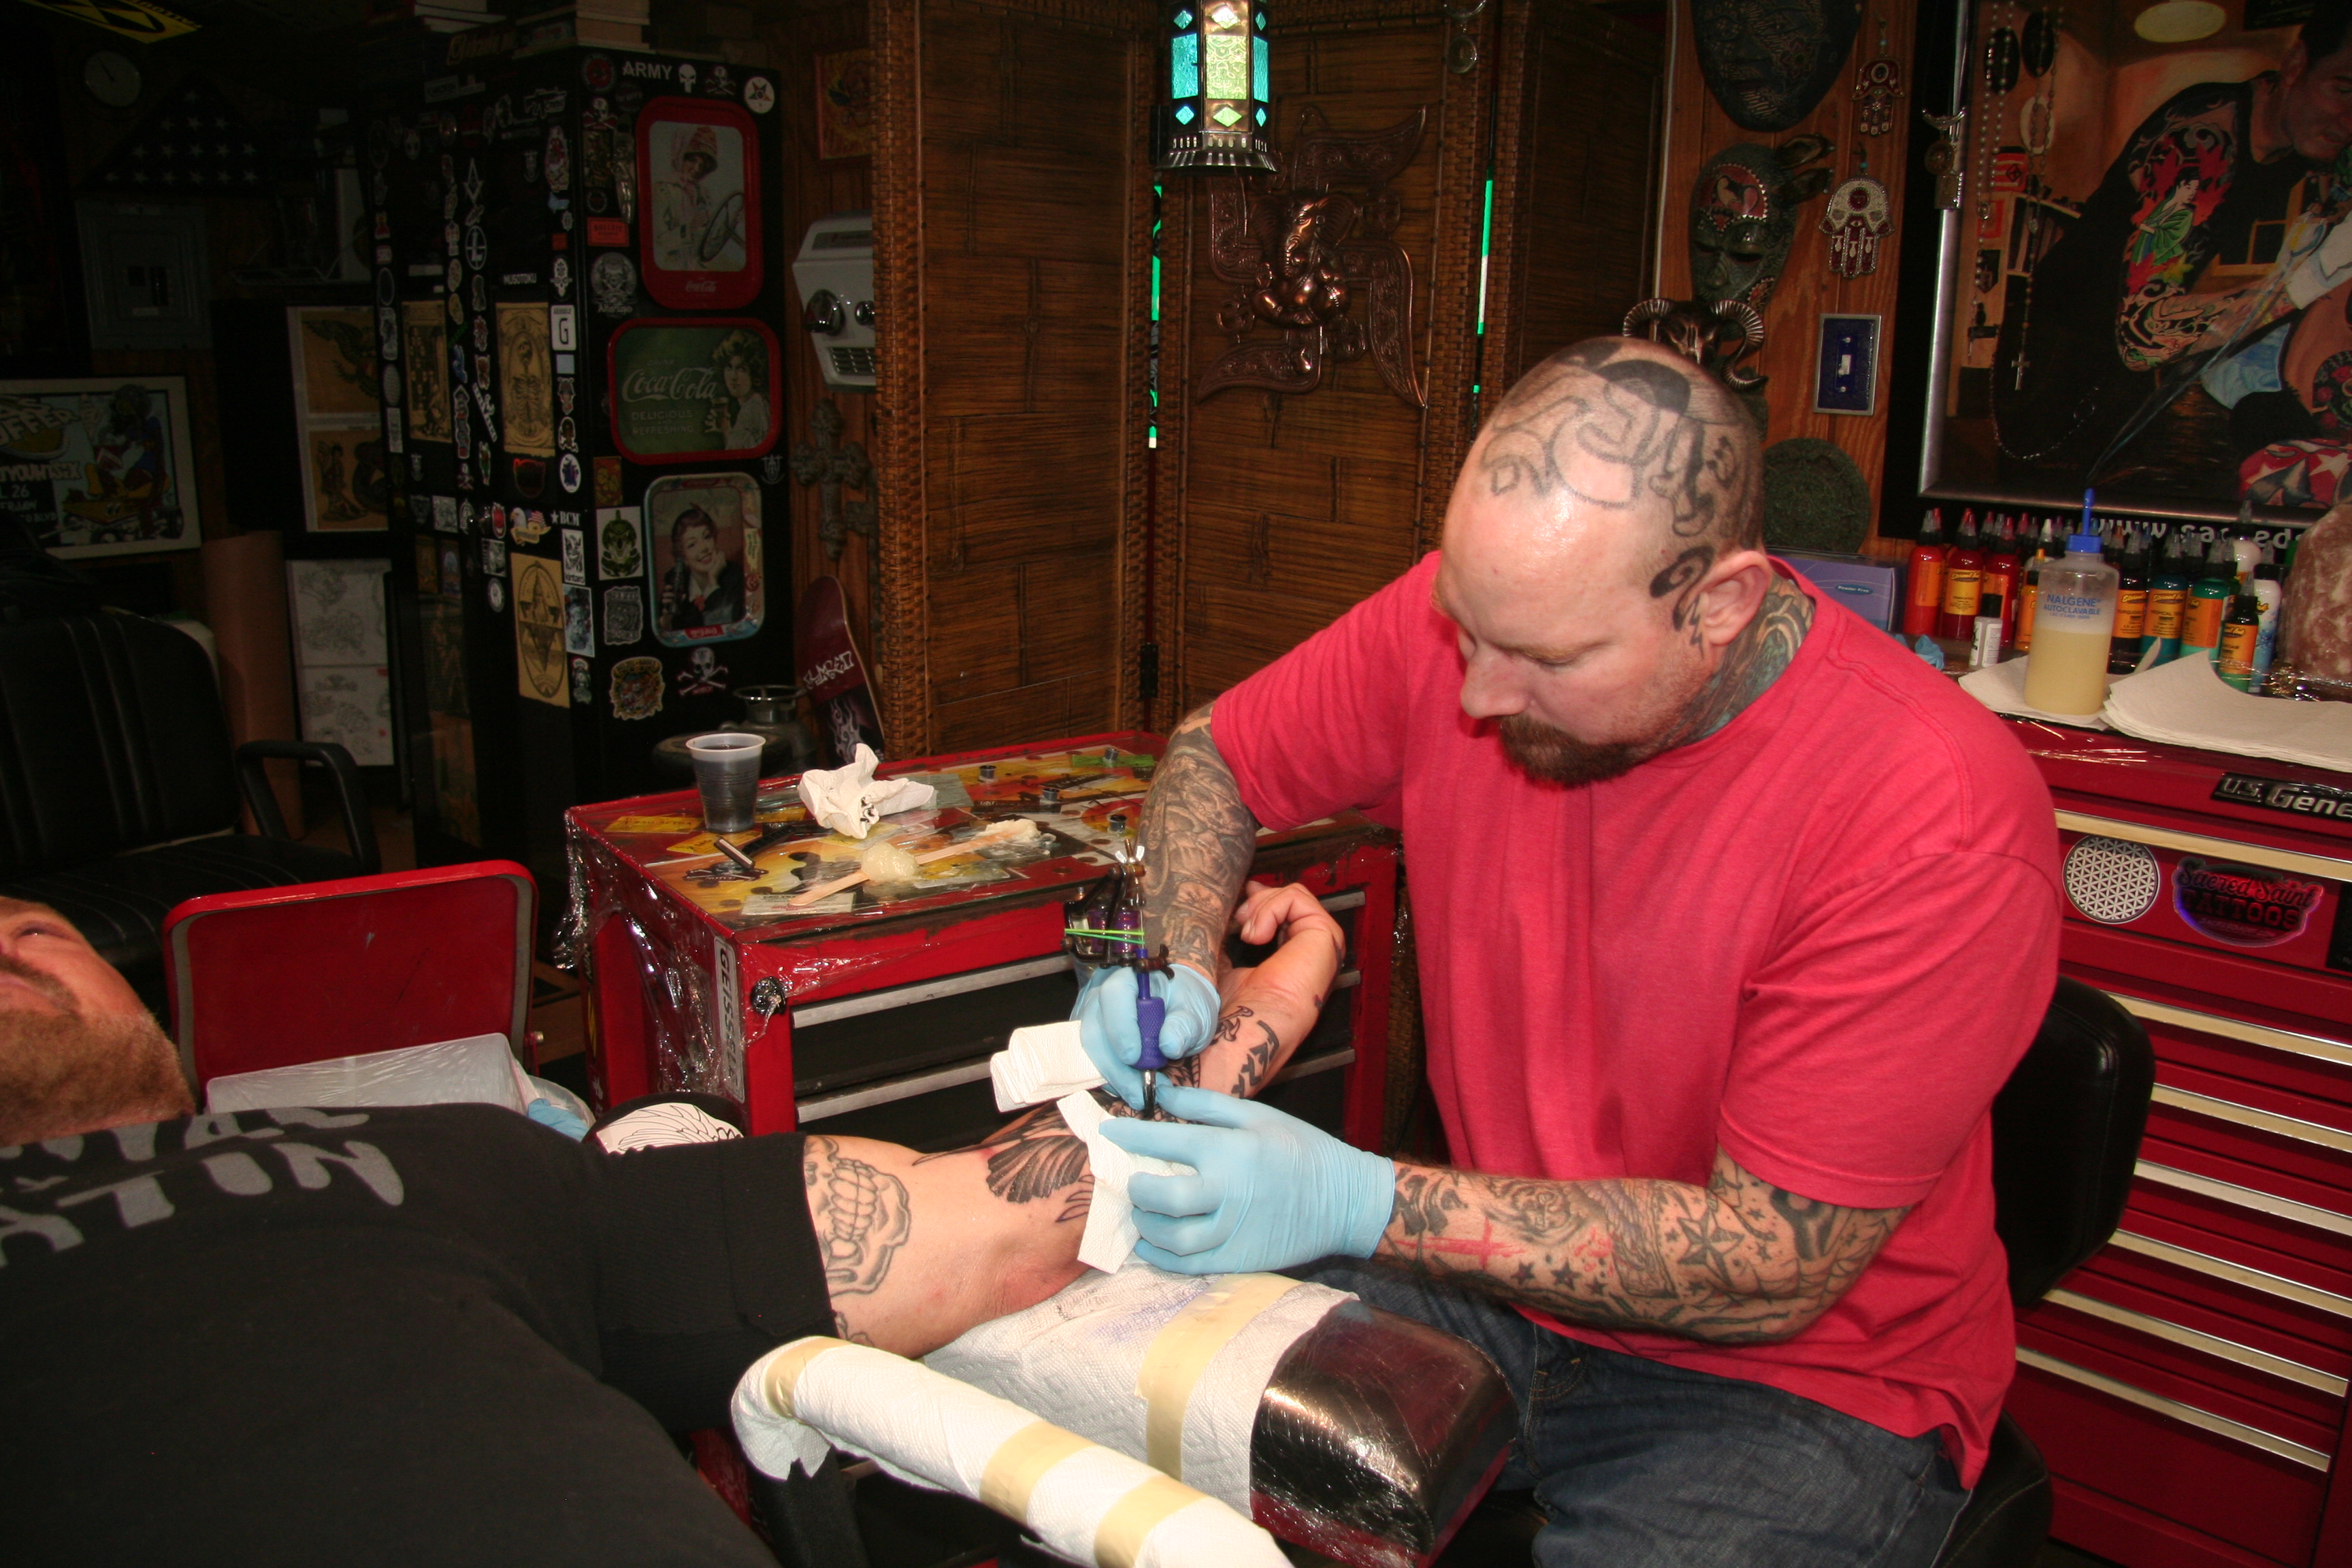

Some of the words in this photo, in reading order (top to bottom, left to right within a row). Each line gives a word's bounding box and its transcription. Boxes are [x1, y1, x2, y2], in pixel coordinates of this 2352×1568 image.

[622, 61, 672, 80] ARMY
[632, 410, 693, 421] DELICIOUS
[632, 425, 693, 436] REFRESHING
[12, 484, 30, 499] 26
[559, 510, 581, 527] BCM
[2046, 593, 2097, 607] NALGENE
[2043, 604, 2102, 615] AUTOCLAVABLE
[2178, 861, 2253, 898] Sacred
[2254, 877, 2317, 909] Saint
[2182, 888, 2301, 930] TATTOOS
